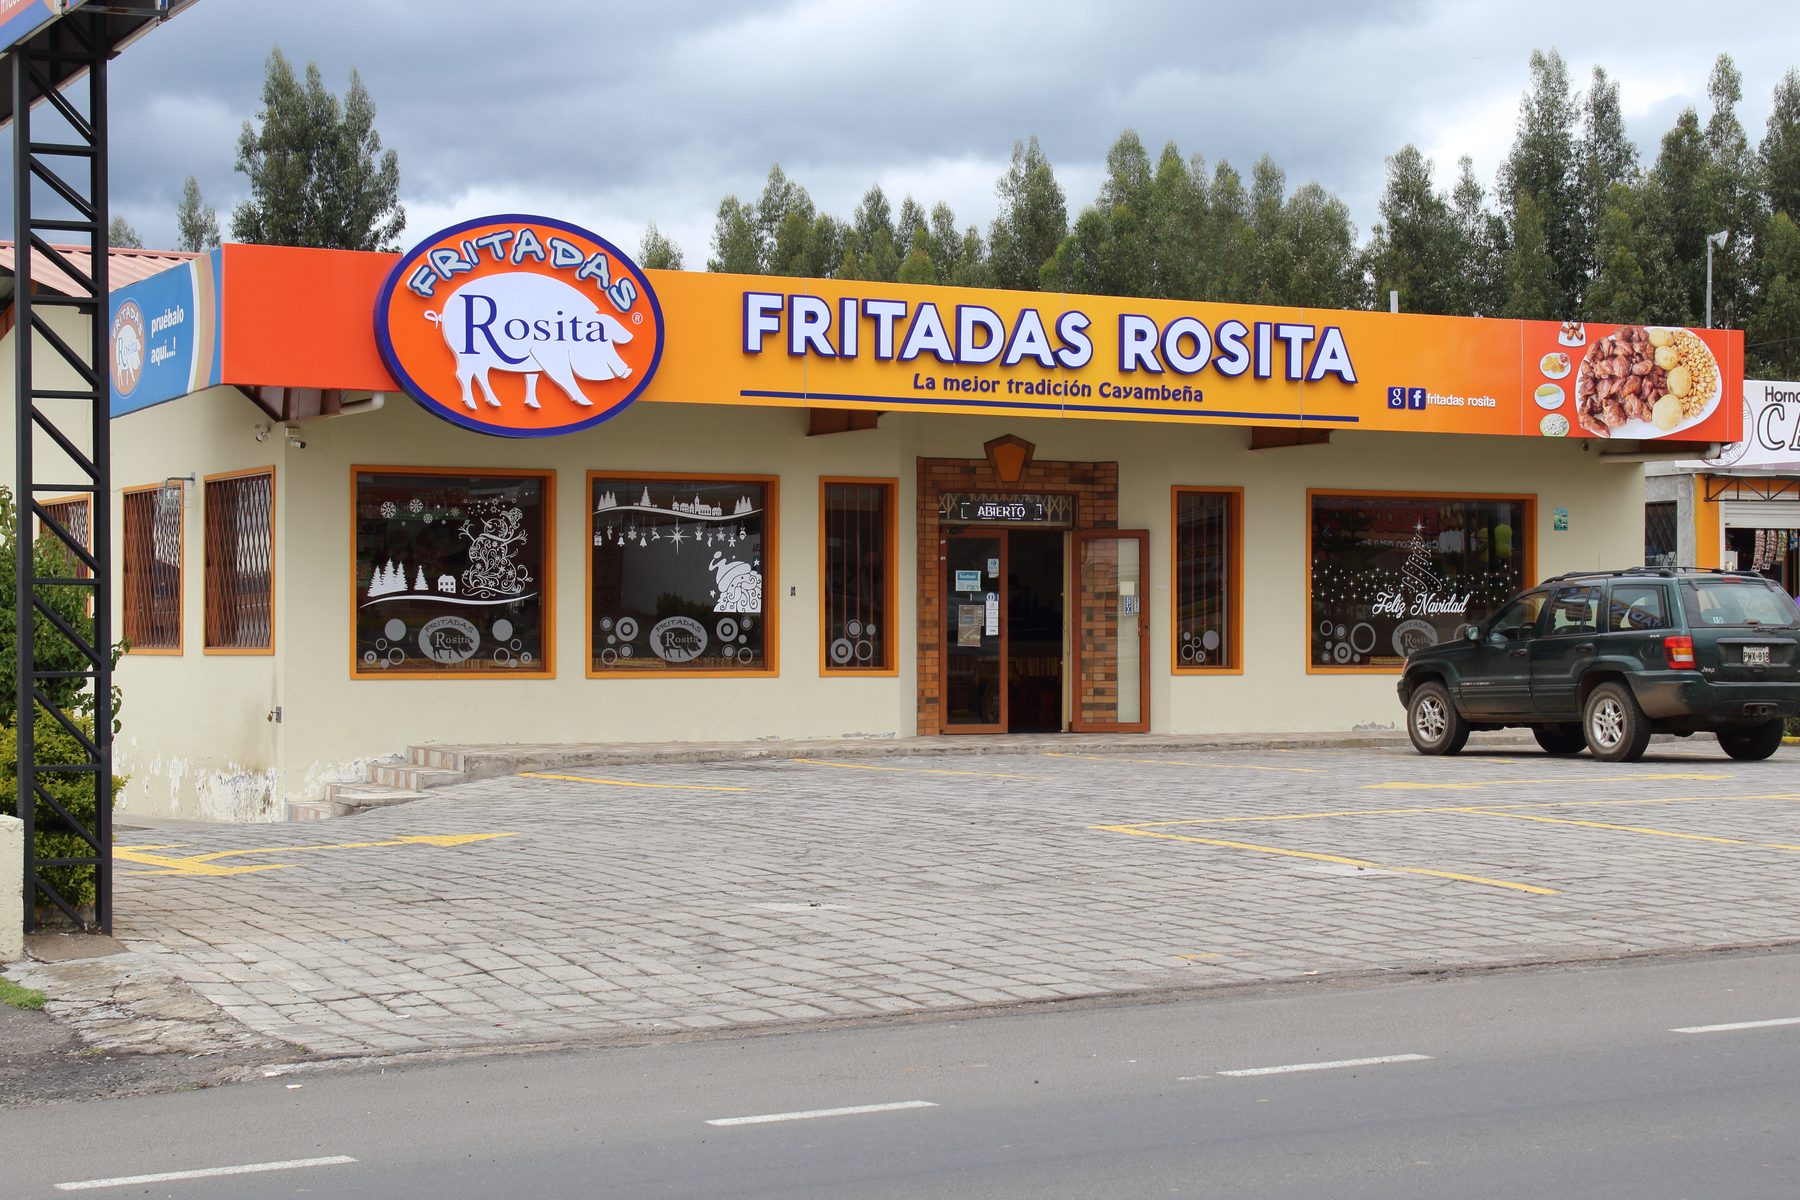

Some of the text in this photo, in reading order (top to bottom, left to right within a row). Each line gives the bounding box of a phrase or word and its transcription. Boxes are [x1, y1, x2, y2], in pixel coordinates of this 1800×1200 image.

[407, 228, 638, 313] FRITADAS
[152, 305, 184, 338] pruébalo
[459, 294, 609, 365] Rosita
[743, 292, 1358, 384] FRITADAS ROSITA
[913, 373, 1204, 402] La mejor tradición Cayambeña
[1427, 393, 1464, 406] fritadas
[1467, 395, 1496, 407] rosita
[977, 505, 1026, 518] ABIERTO
[1372, 588, 1470, 619] Feliz Navidad
[425, 618, 475, 634] FRITADAS
[655, 619, 702, 633] FRITADAS
[434, 632, 470, 649] Rosita
[664, 631, 699, 649] Rosita
